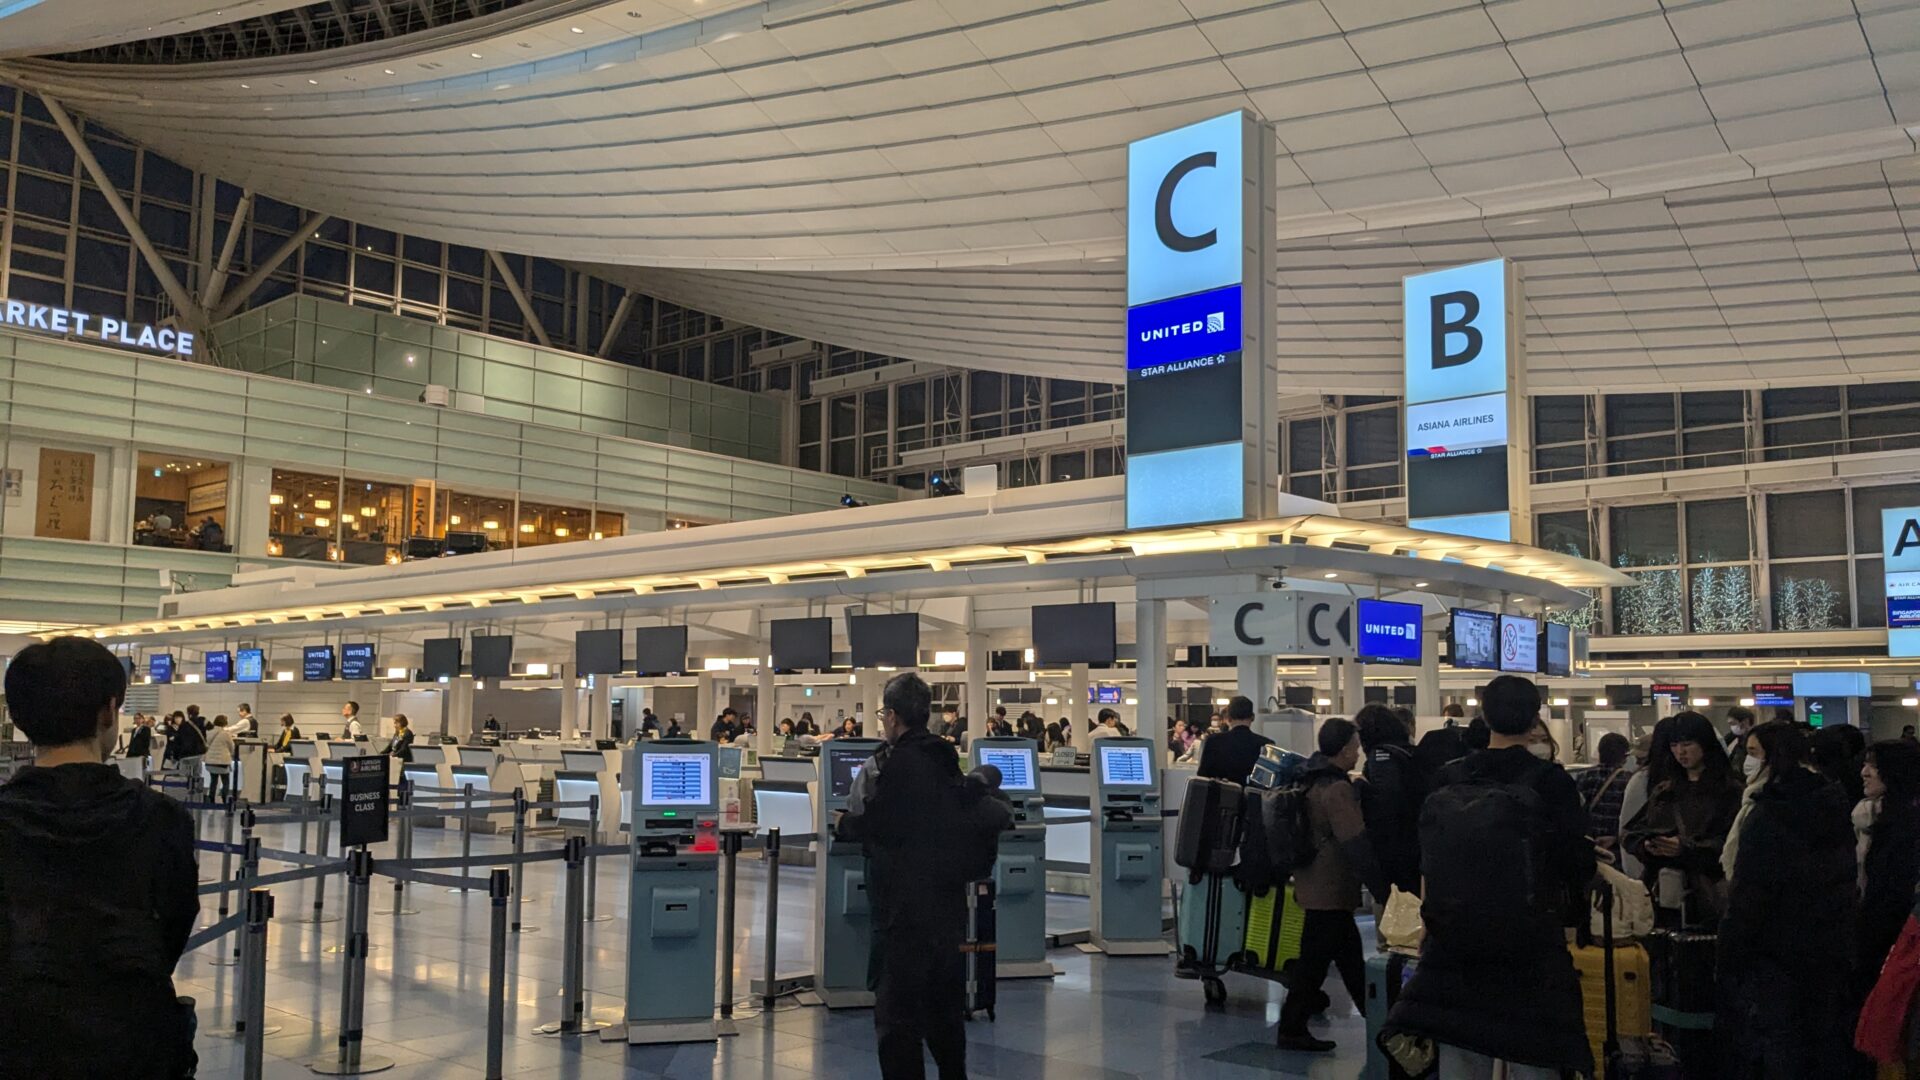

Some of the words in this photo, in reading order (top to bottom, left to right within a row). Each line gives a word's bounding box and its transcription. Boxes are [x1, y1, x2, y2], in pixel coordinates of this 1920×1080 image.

[1154, 151, 1218, 253] C
[100, 317, 194, 356] PLACE
[1141, 320, 1204, 342] UNITED
[1430, 290, 1483, 370] B
[1141, 365, 1165, 377] STAR
[1166, 356, 1214, 373] ALLIANCE
[1417, 419, 1450, 432] ASIANA
[1452, 414, 1494, 427] AIRLINES
[1430, 452, 1446, 460] STAR
[1446, 449, 1476, 457] ALLIANCE
[1892, 518, 1920, 557] A
[1233, 602, 1264, 646] C
[1308, 602, 1331, 647] C
[1365, 623, 1405, 636] UNITED
[349, 791, 381, 802] BUSINESS
[354, 802, 375, 812] CLASS
